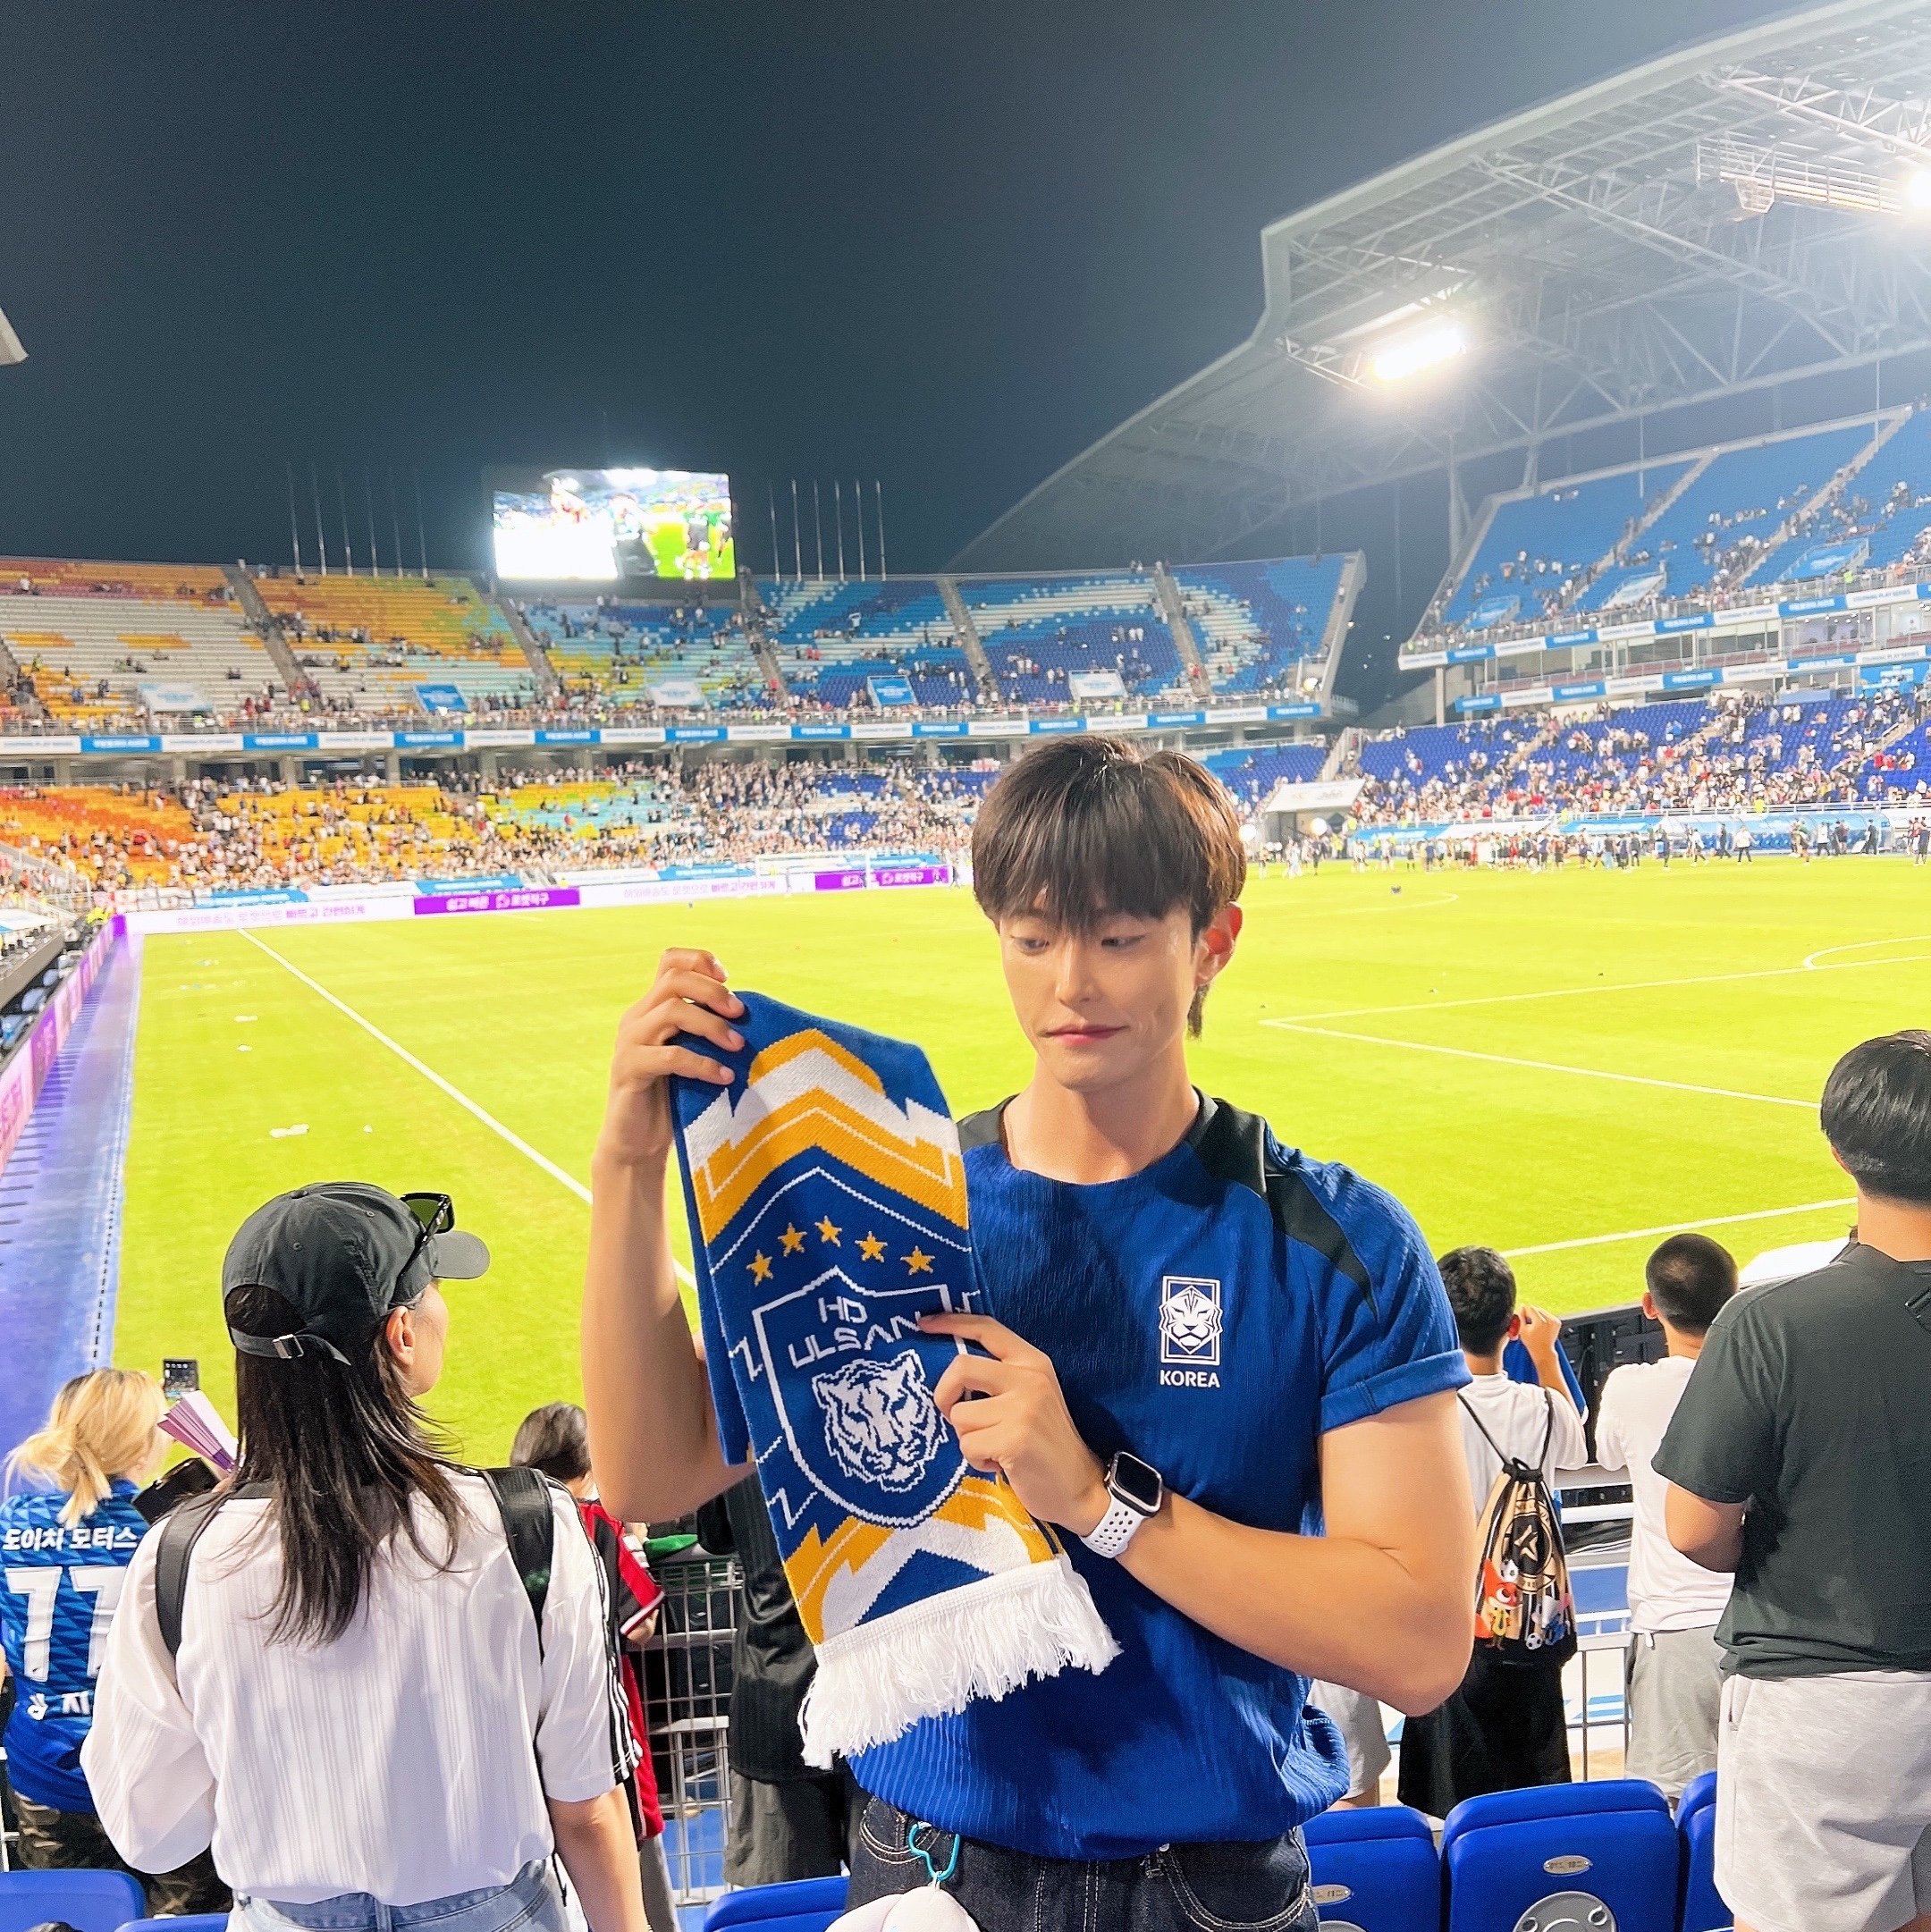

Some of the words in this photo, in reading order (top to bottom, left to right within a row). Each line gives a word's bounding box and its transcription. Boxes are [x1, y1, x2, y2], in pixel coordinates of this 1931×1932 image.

[817, 1295, 868, 1324] HD
[788, 1311, 921, 1369] ULSAN
[1159, 1369, 1221, 1388] KOREA
[3, 1526, 63, 1552] 도이치
[69, 1524, 138, 1551] 모터스
[5, 1565, 128, 1683] 77
